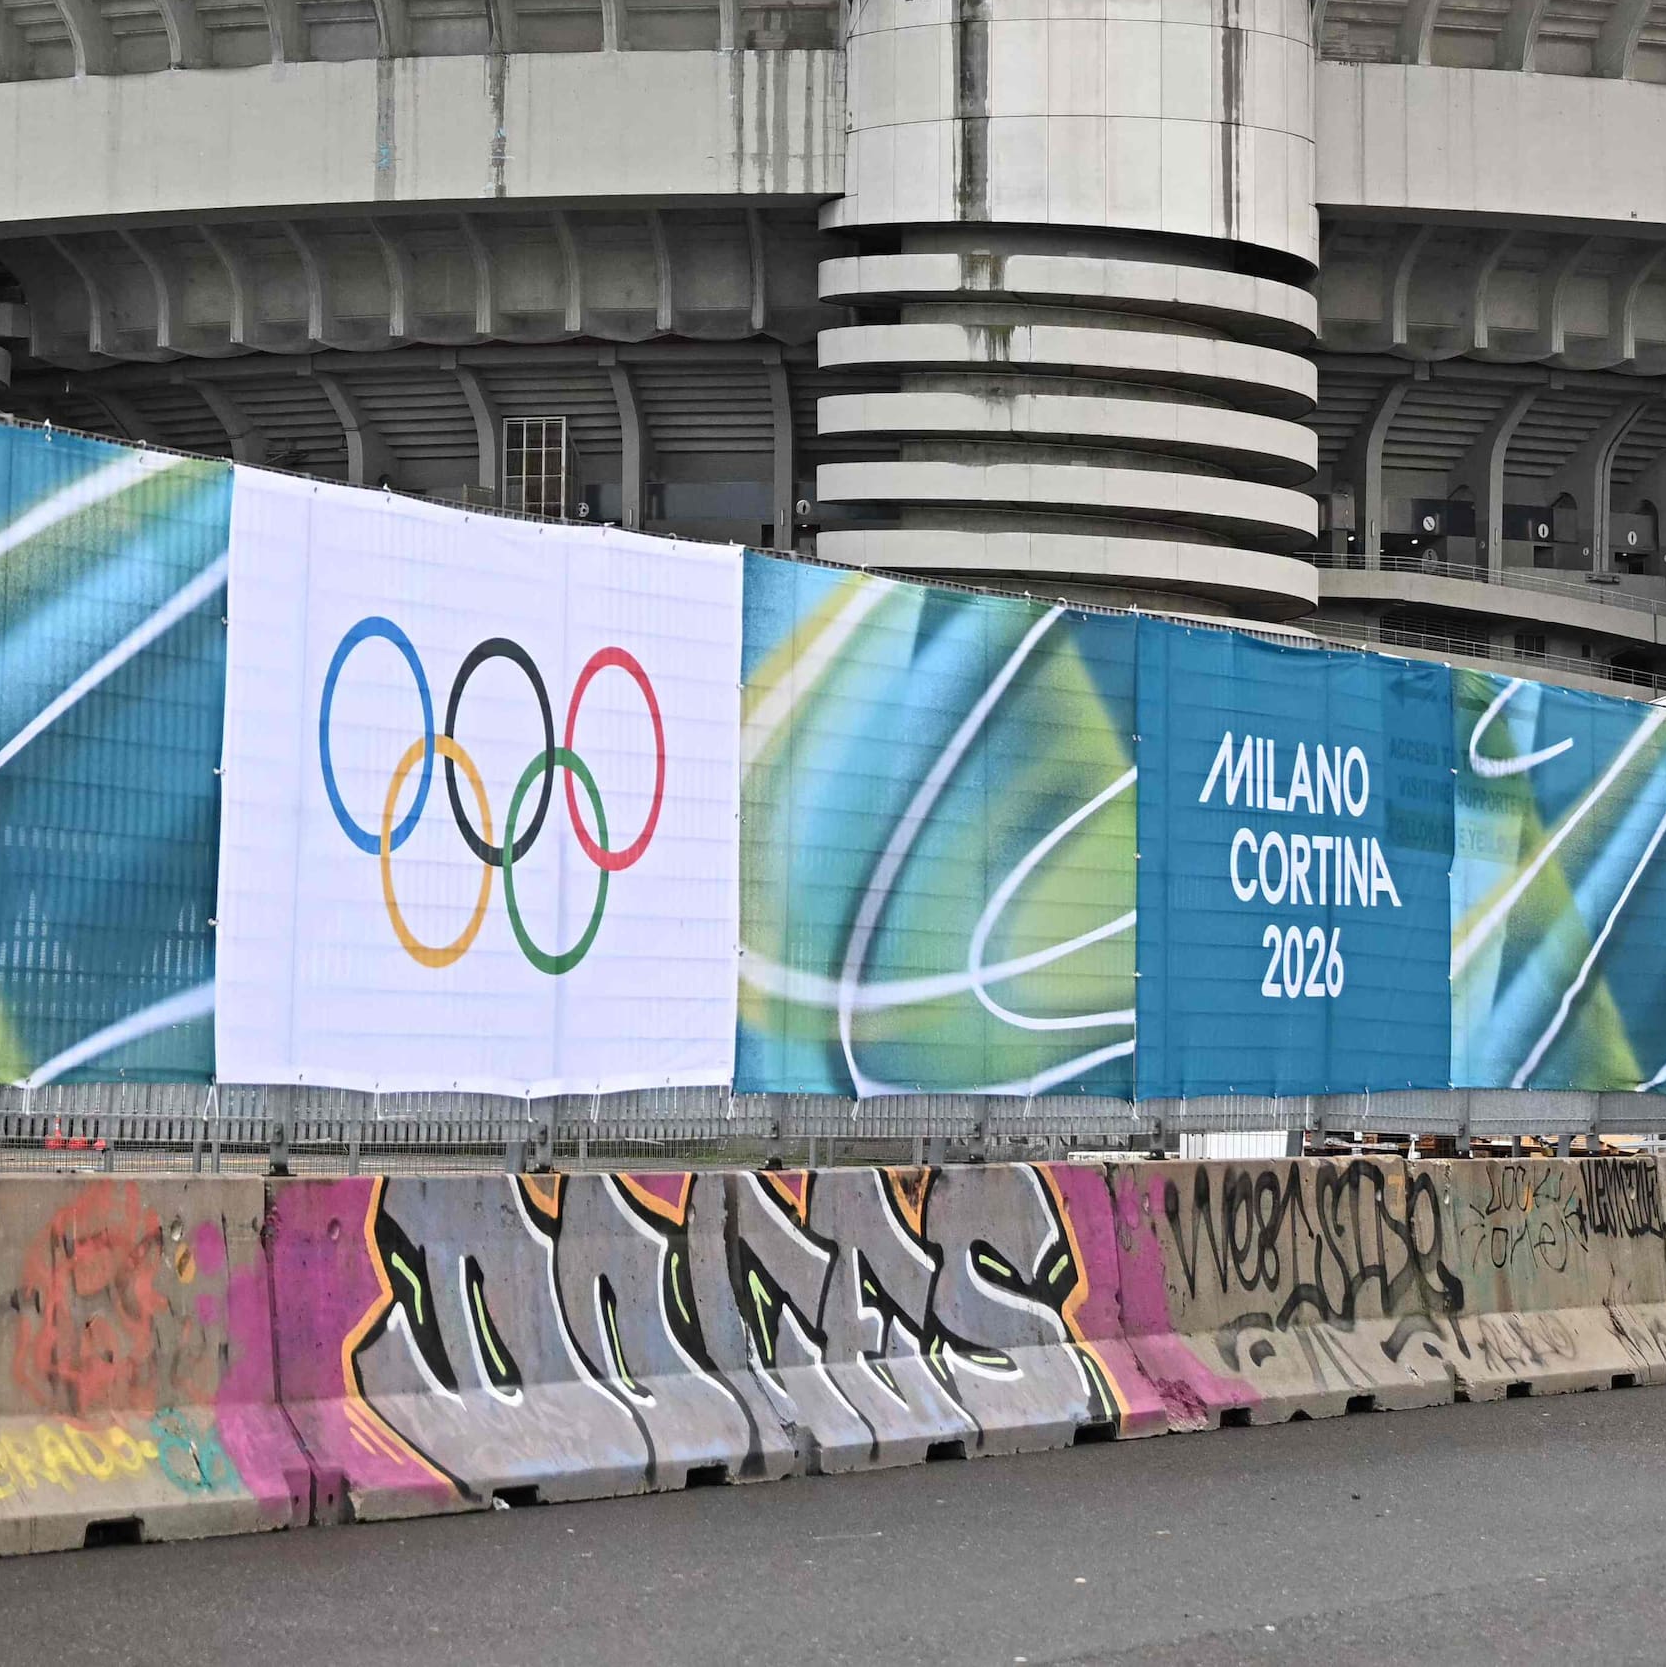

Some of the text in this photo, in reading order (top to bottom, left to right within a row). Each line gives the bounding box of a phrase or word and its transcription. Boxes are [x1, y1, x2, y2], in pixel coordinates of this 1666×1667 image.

[1198, 731, 1370, 817] MILANO
[1230, 827, 1403, 908] CORTINA
[1261, 924, 1345, 999] 2026
